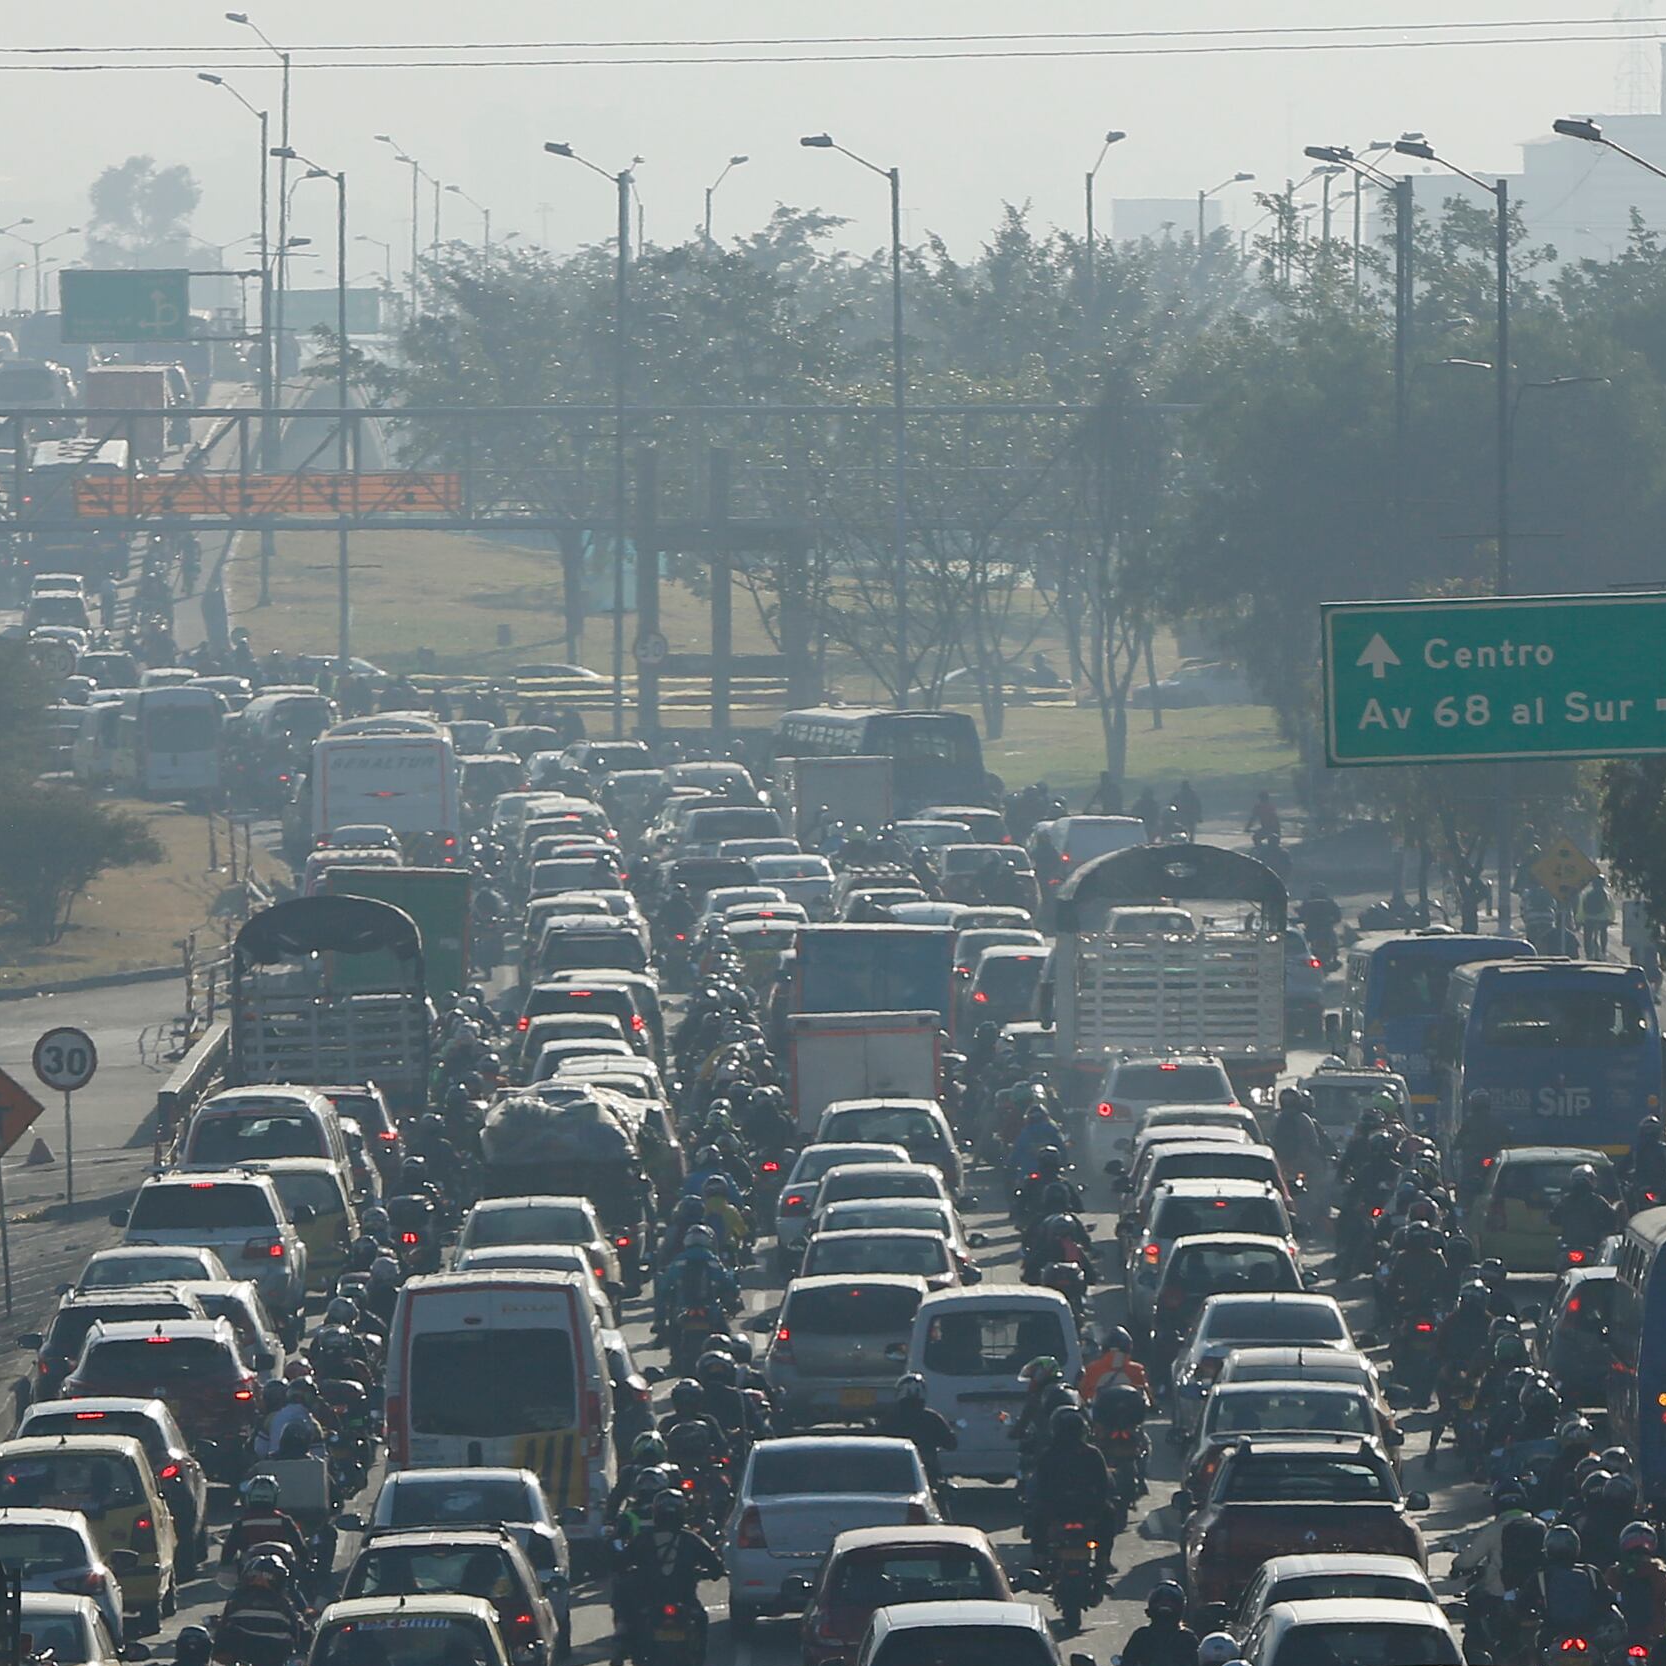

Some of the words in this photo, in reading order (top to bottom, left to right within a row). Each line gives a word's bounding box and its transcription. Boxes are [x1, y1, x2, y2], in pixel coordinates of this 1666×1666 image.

[1423, 638, 1554, 670] Centro
[1358, 698, 1413, 731] Av
[1434, 694, 1491, 728] 68
[1512, 697, 1544, 726] al
[1565, 691, 1632, 723] Sur
[44, 1046, 88, 1076] 30
[1537, 1086, 1591, 1119] SiTP
